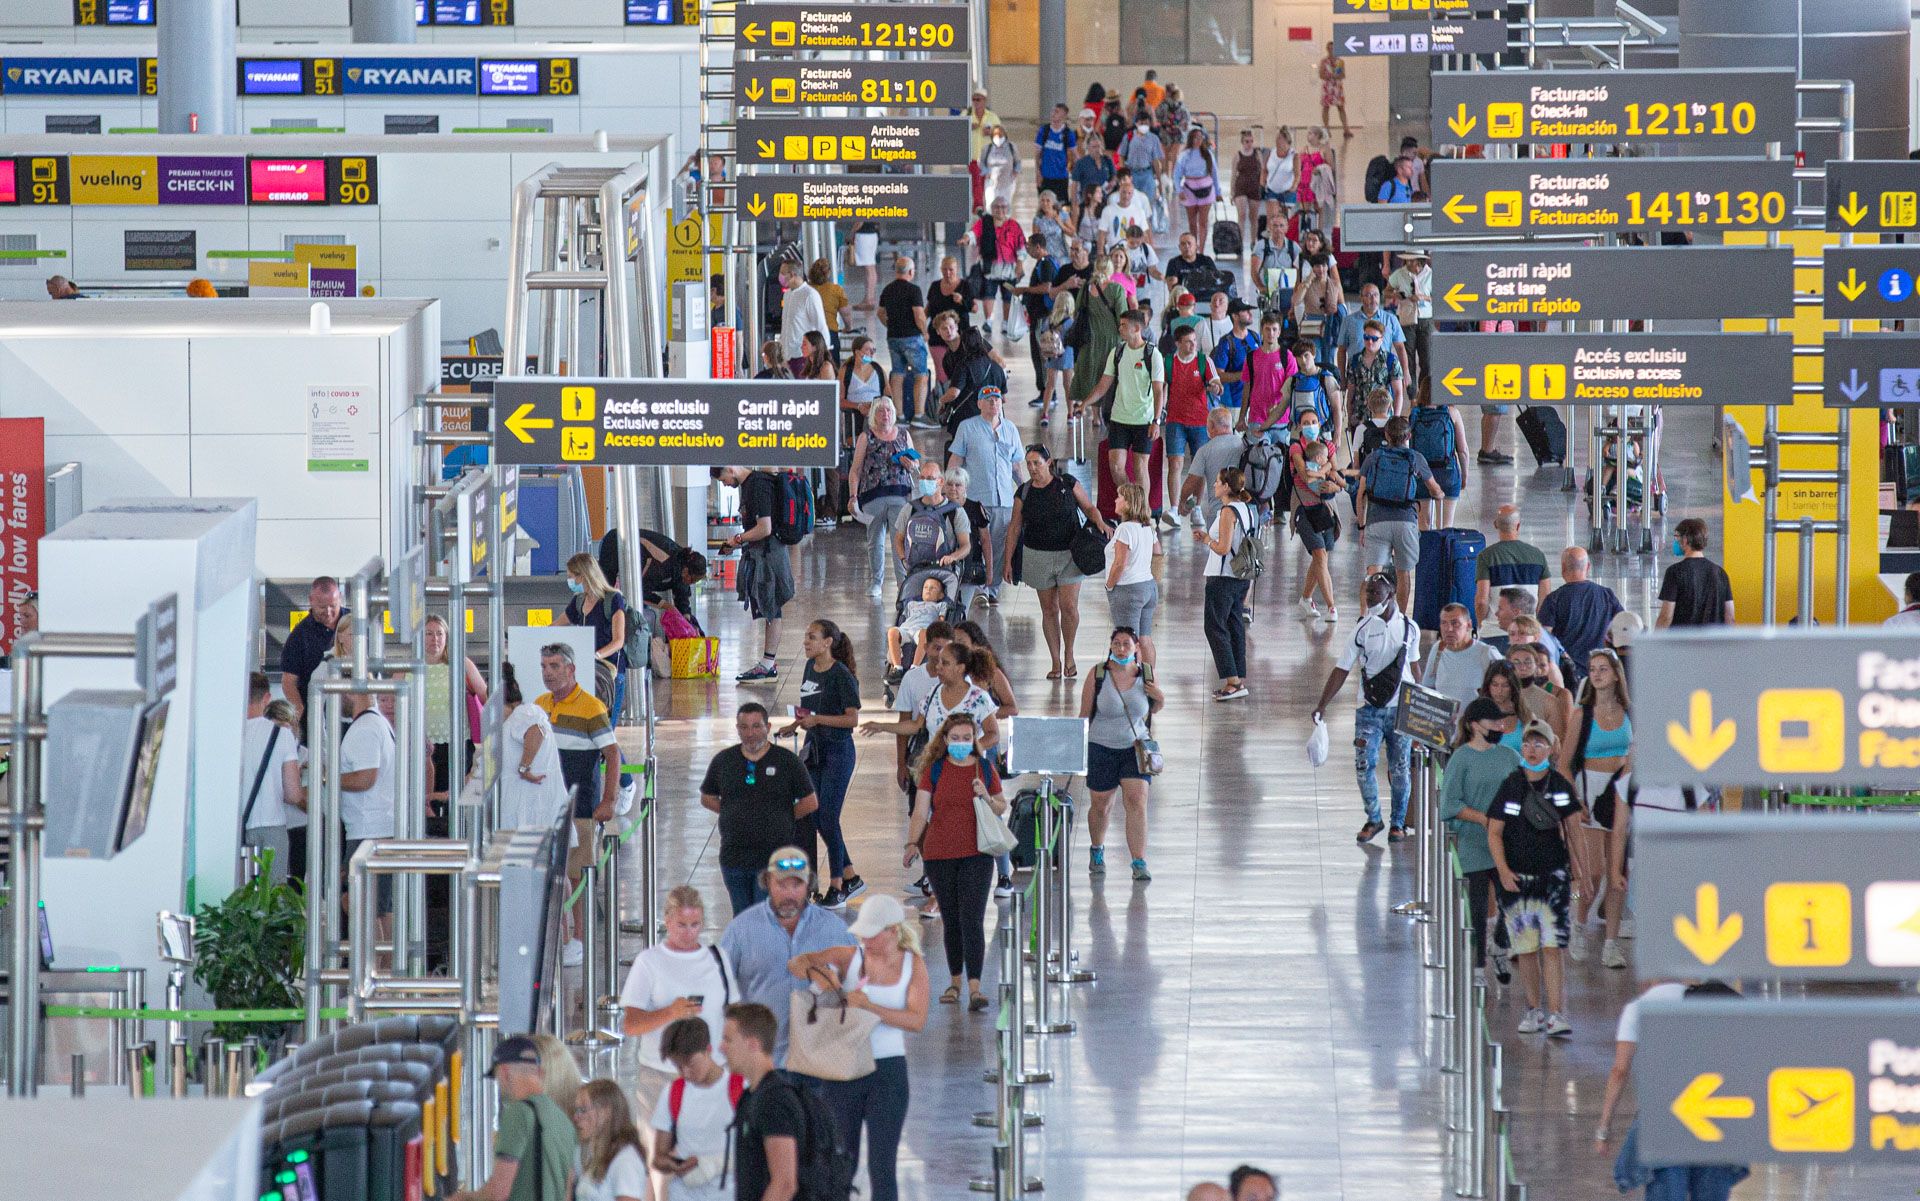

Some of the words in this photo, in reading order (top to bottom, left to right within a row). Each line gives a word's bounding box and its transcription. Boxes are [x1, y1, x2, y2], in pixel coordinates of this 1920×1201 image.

[81, 12, 96, 25] 14
[800, 11, 852, 23] Facturació
[801, 23, 839, 33] Check-in
[860, 23, 907, 47] 121
[908, 26, 918, 35] to
[920, 23, 954, 47] 90
[800, 34, 857, 46] Facturación
[24, 68, 134, 85] RYANAIR
[254, 73, 299, 82] RYANAIR
[363, 68, 473, 85] RYANAIR
[800, 68, 852, 80] Facturació
[146, 80, 157, 94] 5
[314, 79, 335, 95] 51
[549, 78, 573, 94] 50
[801, 79, 839, 90] Check-in
[861, 79, 892, 103] 81
[894, 82, 904, 91] to
[905, 79, 937, 103] 10
[800, 91, 857, 103] Facturación
[1530, 86, 1609, 102] Facturació
[1530, 103, 1588, 118] Check-in
[1692, 103, 1707, 116] to
[1624, 102, 1691, 136] 121
[1710, 101, 1756, 135] 10
[870, 124, 920, 136] Arribades
[1530, 120, 1617, 136] Facturación
[1694, 122, 1705, 134] a
[870, 137, 904, 148] Arrivals
[871, 148, 917, 161] Llegadas
[80, 170, 143, 190] vueling
[167, 180, 235, 192] CHECK-IN
[1529, 174, 1610, 190] Facturació
[32, 183, 58, 203] 91
[339, 183, 370, 204] 90
[803, 182, 860, 195] Equipatges
[861, 182, 909, 195] especials
[268, 192, 309, 201] CERRADO
[803, 194, 835, 206] Special
[836, 194, 873, 205] check-in
[1530, 192, 1589, 207] Check-in
[1695, 192, 1711, 205] to
[803, 206, 853, 218] Equipajes
[855, 206, 909, 218] especiales
[1624, 191, 1695, 225] 141
[1713, 191, 1786, 225] 130
[1529, 209, 1619, 225] Facturación
[1698, 211, 1708, 223] a
[684, 225, 690, 241] 1
[320, 251, 346, 261] vueling
[1486, 263, 1528, 279] Carril
[1532, 262, 1572, 281] ràpid
[311, 280, 346, 290] REMIUM
[1487, 281, 1515, 296] Fast
[1517, 281, 1547, 295] lane
[1486, 299, 1528, 314] Carril
[1532, 297, 1581, 315] rápido
[1574, 347, 1621, 363] Accés
[1625, 348, 1687, 363] exclusiu
[441, 362, 503, 379] ECURE
[1573, 366, 1635, 380] Exclusive
[1636, 368, 1682, 380] access
[1574, 383, 1629, 398] Acceso
[1632, 383, 1703, 398] exclusivo
[603, 399, 648, 415] Accés
[651, 400, 709, 415] exclusiu
[738, 400, 778, 415] Carril
[782, 399, 819, 419] ràpid
[603, 416, 659, 430] Exclusive
[662, 418, 703, 430] access
[738, 417, 763, 431] Fast
[766, 417, 792, 431] lane
[604, 432, 655, 448] Acceso
[659, 432, 725, 448] exclusivo
[738, 432, 778, 448] Carril
[781, 432, 828, 451] rápido
[8, 472, 27, 530] fares
[1793, 489, 1807, 498] sin
[1809, 489, 1839, 498] barrer
[8, 535, 27, 574] low
